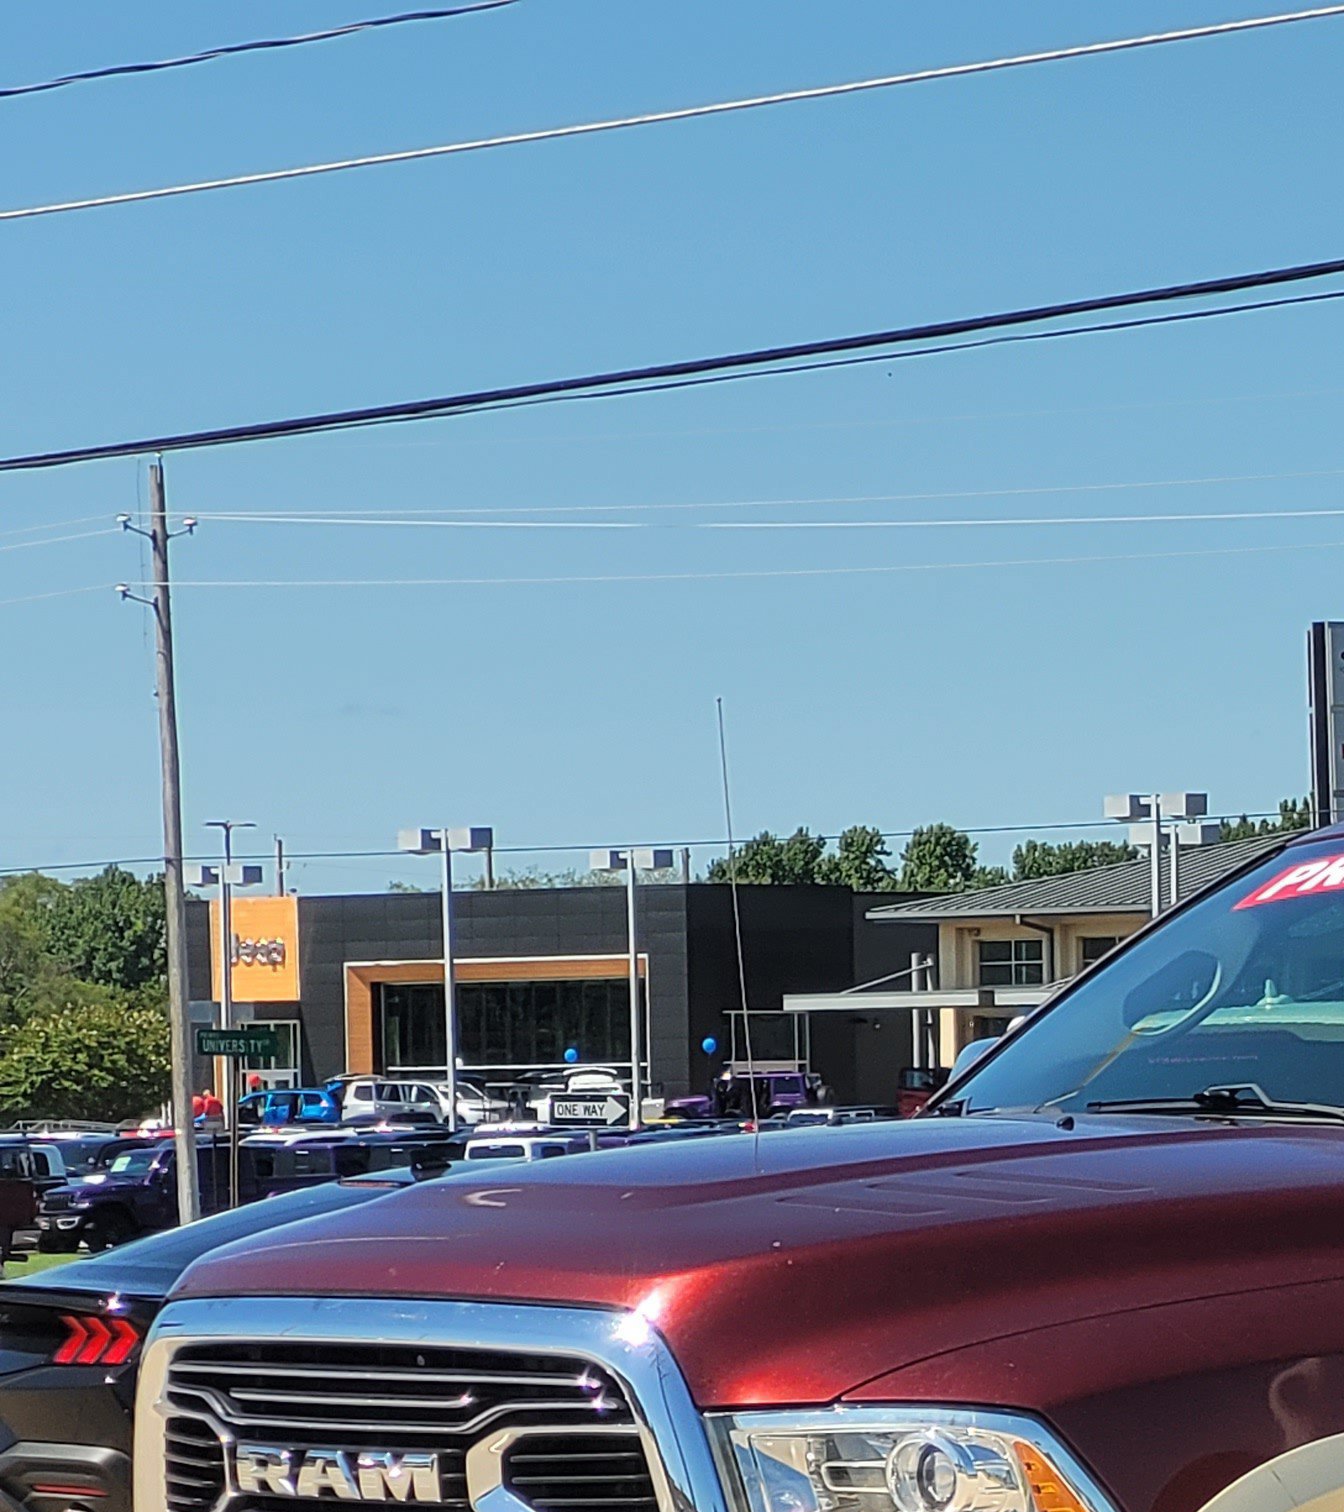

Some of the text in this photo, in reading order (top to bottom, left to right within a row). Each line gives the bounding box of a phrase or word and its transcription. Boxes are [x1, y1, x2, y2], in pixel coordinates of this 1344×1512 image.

[202, 1039, 262, 1053] UNIVERSITY
[556, 1103, 605, 1117] ONE WAY
[236, 1444, 442, 1504] RAM
